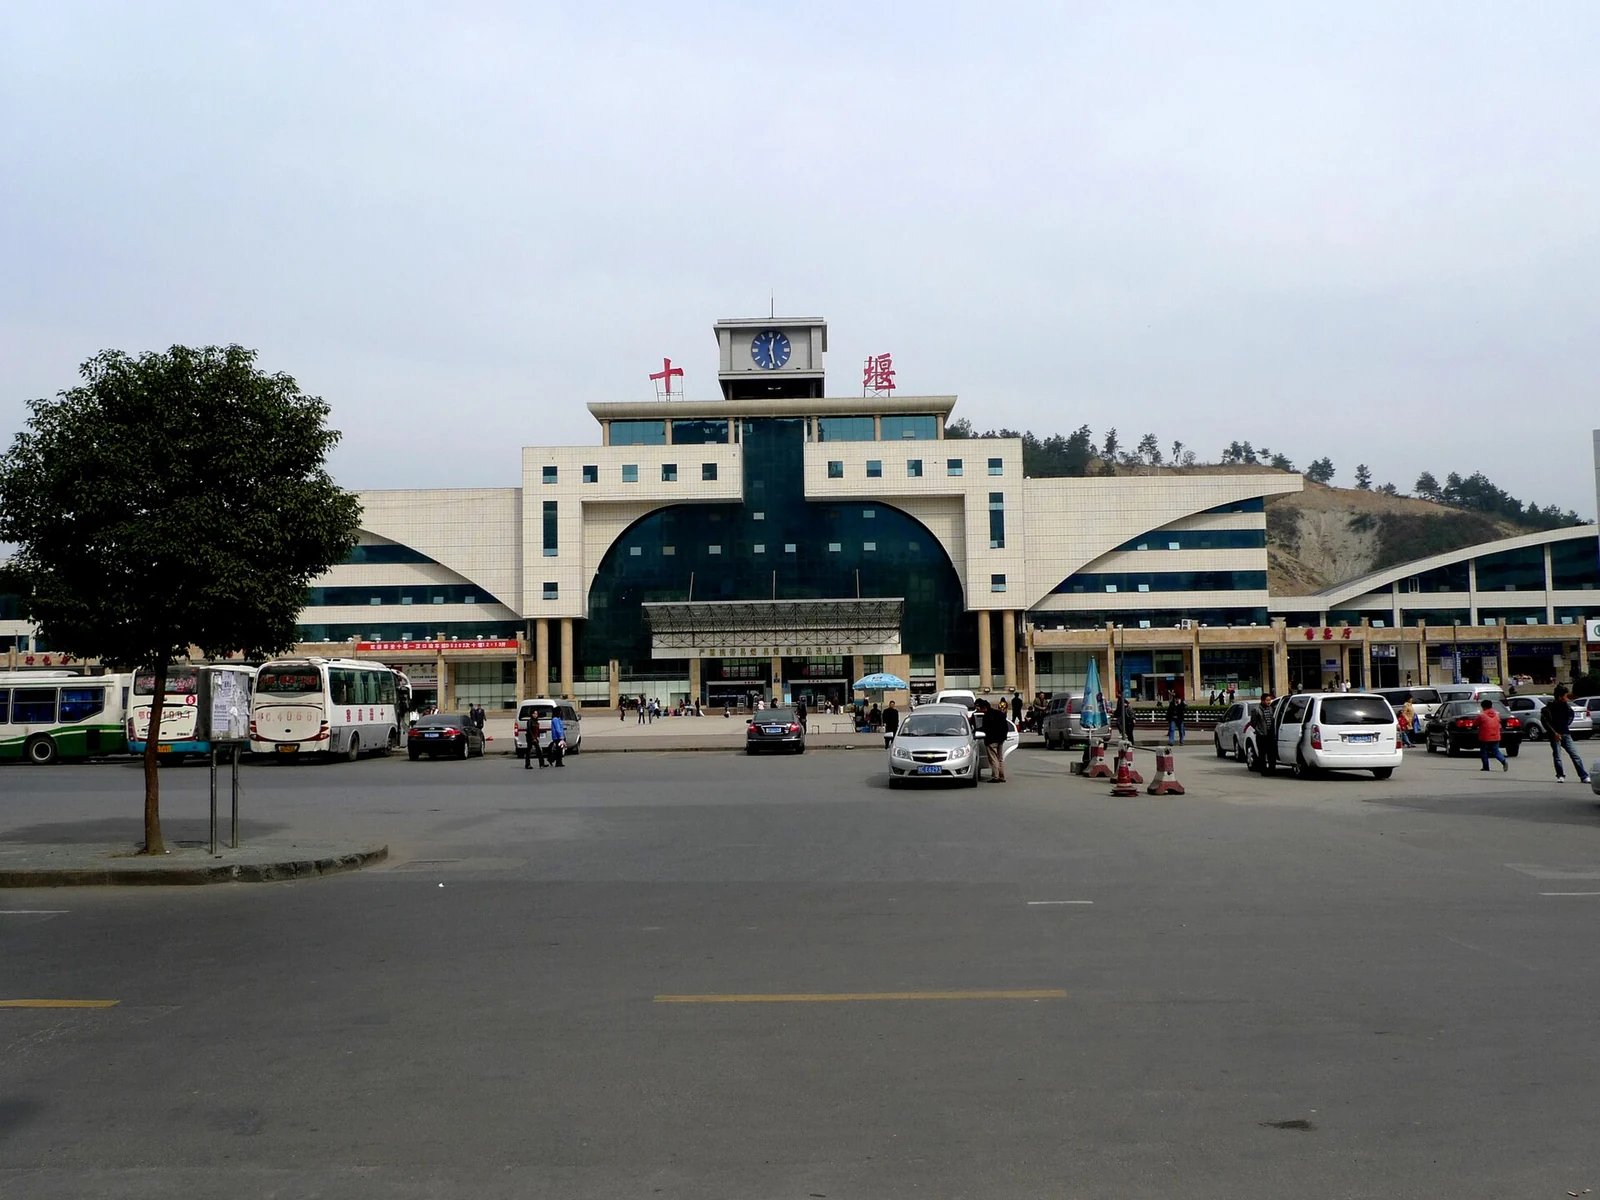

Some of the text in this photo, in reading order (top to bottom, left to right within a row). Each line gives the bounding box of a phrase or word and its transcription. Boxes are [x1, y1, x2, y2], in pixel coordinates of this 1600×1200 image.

[649, 353, 896, 393] 十 堰
[1304, 628, 1352, 640] 售票厅
